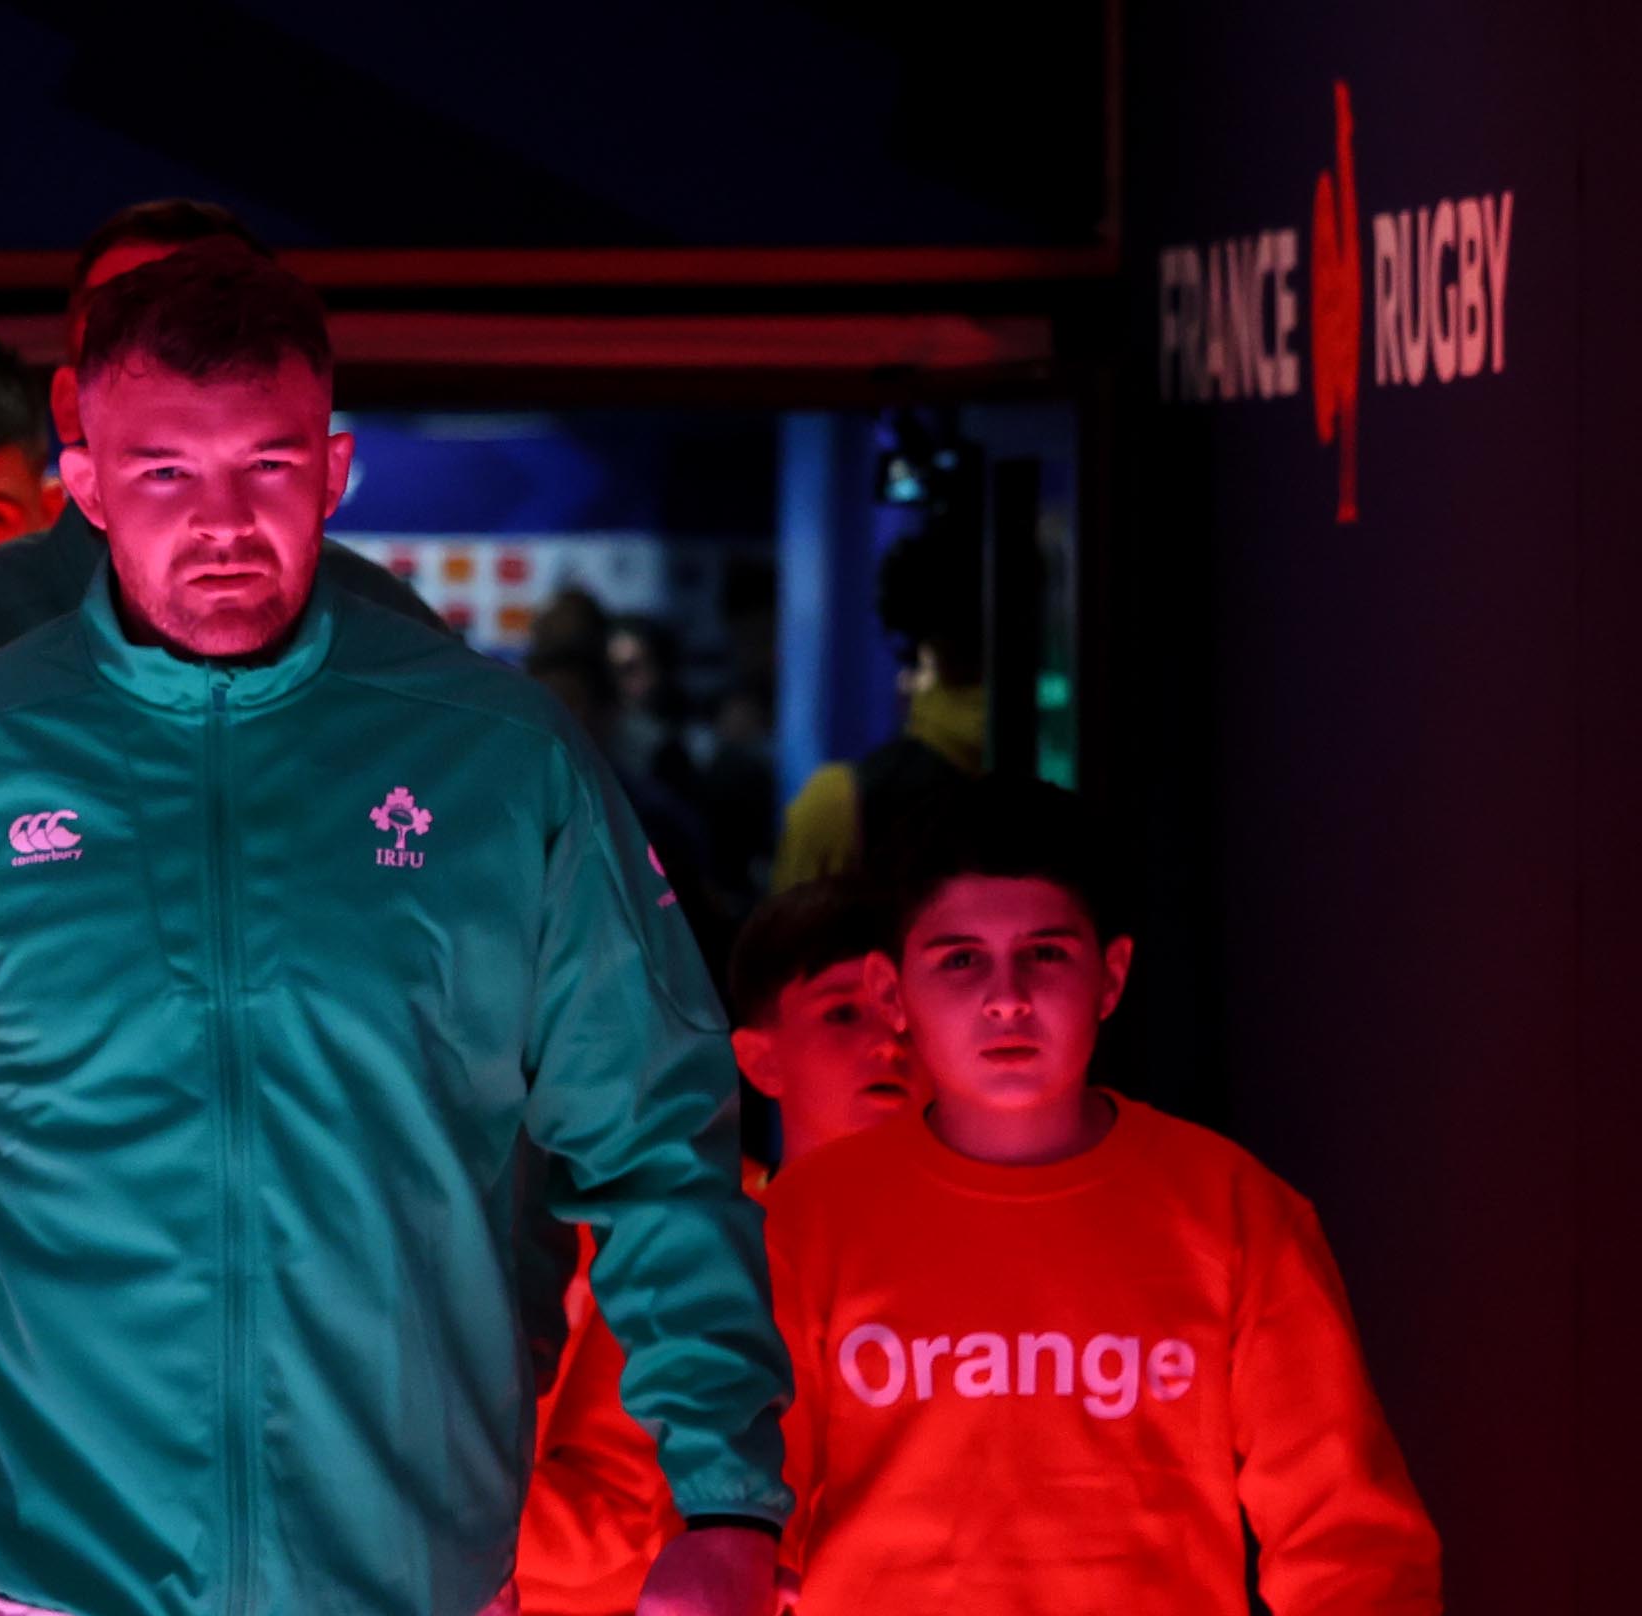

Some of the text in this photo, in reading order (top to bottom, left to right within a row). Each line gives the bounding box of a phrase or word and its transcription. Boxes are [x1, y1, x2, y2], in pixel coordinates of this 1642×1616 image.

[1157, 190, 1514, 405] FRANCE RUGBY
[376, 848, 424, 868] IRFU
[839, 1323, 1196, 1420] Orange
